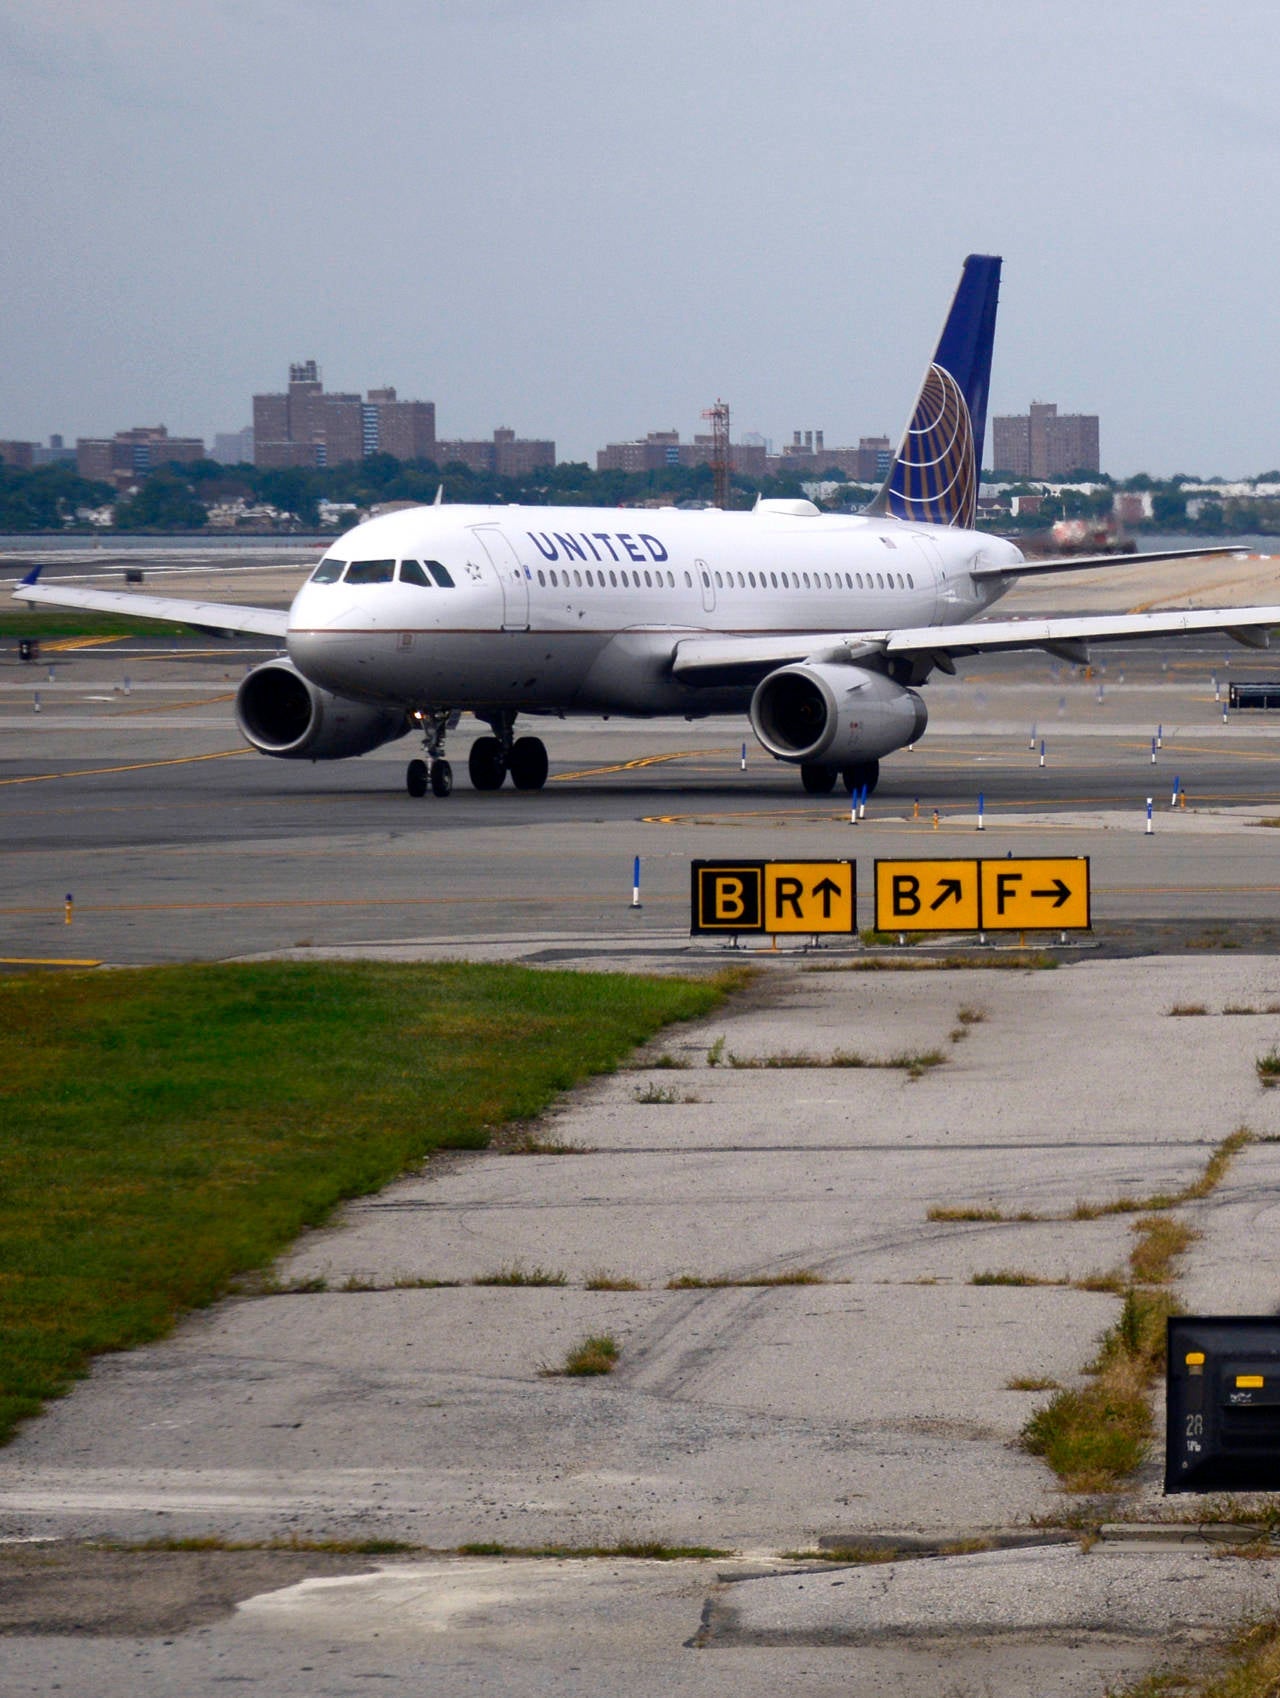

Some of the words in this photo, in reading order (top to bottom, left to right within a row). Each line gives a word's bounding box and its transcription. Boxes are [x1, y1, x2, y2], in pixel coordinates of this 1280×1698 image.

[526, 532, 668, 561] UNITED
[715, 877, 744, 919] B
[775, 877, 804, 919] R
[893, 875, 921, 916] B
[997, 873, 1023, 915] F
